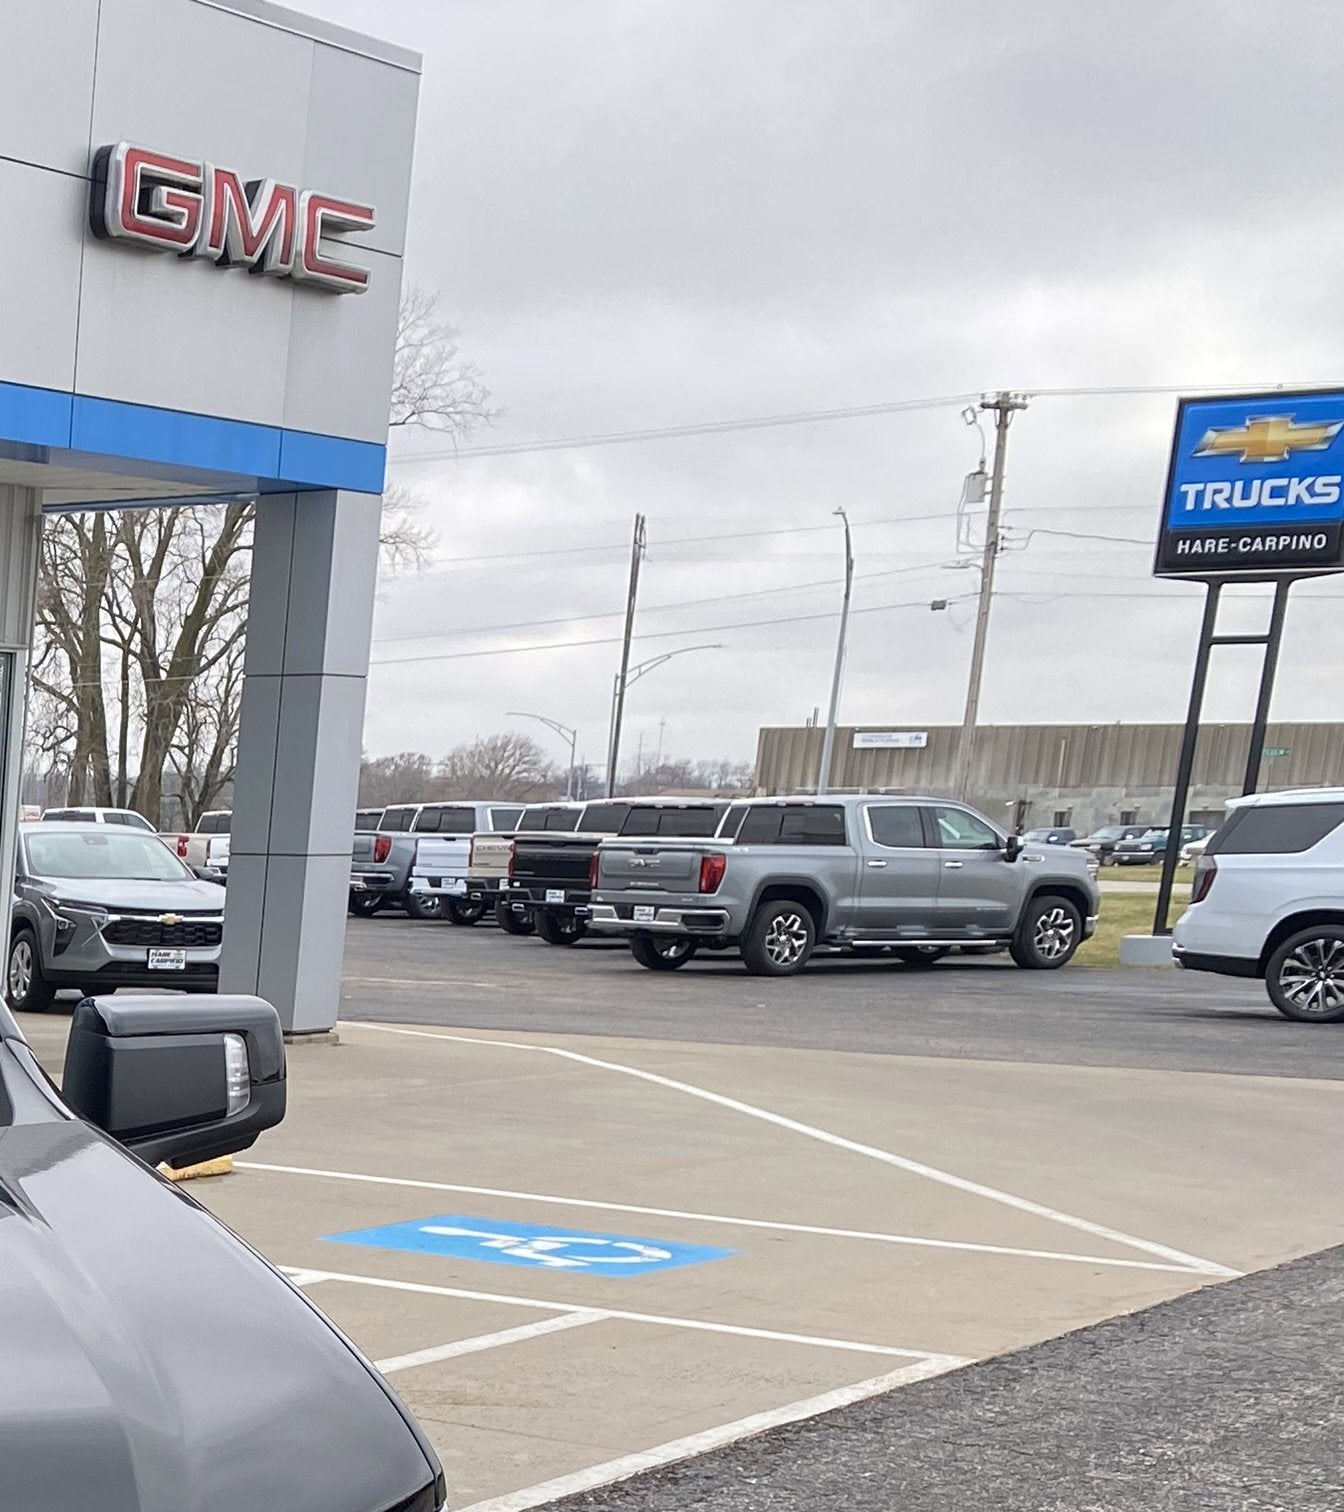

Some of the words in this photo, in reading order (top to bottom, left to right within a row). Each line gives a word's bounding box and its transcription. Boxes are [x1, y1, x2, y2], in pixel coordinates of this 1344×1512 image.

[92, 140, 376, 294] GMC
[1179, 474, 1343, 512] TRUCKS
[1176, 533, 1328, 555] HARE-CARPINO
